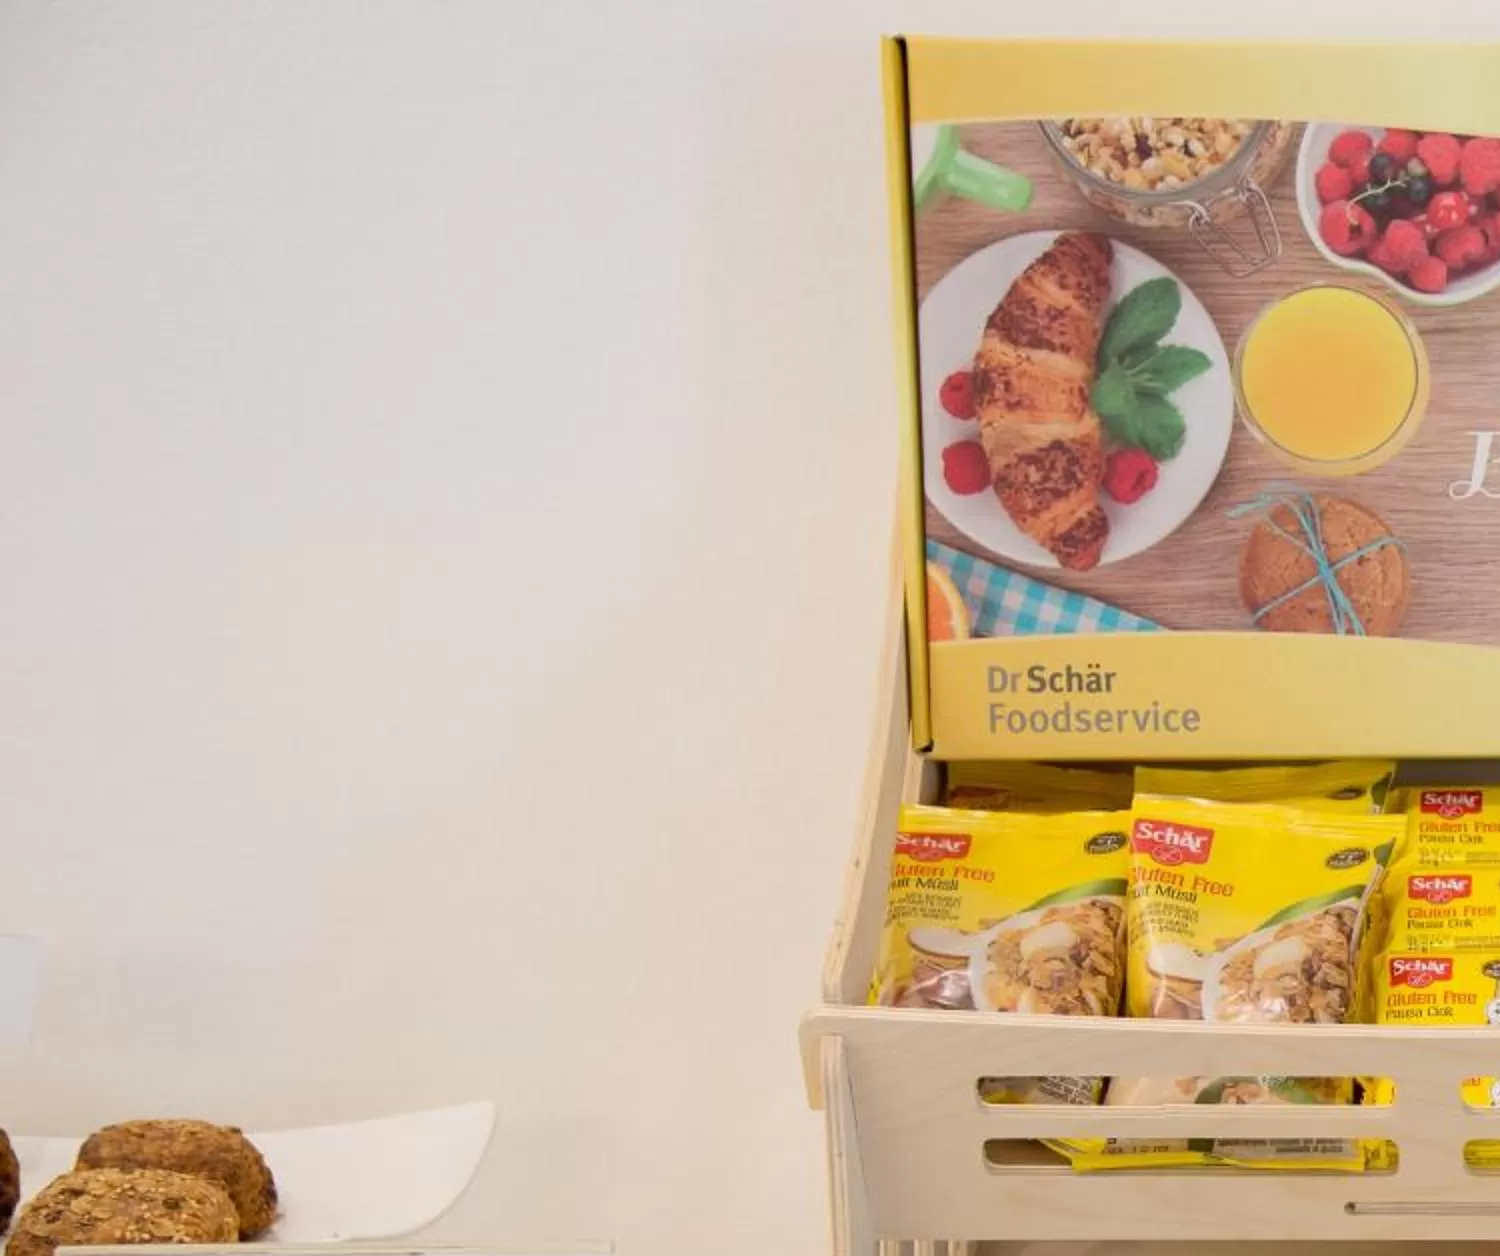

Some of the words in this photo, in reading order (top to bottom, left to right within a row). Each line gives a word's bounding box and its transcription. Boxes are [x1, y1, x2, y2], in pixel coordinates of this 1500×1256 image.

[986, 664, 1022, 693] Dr
[1026, 664, 1117, 693] Schär
[987, 701, 1202, 735] Foodservice
[1423, 791, 1479, 808] Schär
[1419, 821, 1468, 833] Gluten
[896, 832, 967, 852] Schär
[1134, 821, 1209, 853] Schär
[895, 863, 945, 878] luten
[953, 866, 995, 883] Free
[1192, 874, 1235, 897] Free
[1411, 875, 1469, 892] Schär
[1407, 907, 1458, 919] Gluten
[1463, 905, 1497, 918] Free
[1392, 958, 1450, 976] Schär
[1387, 991, 1437, 1007] Gluten
[1443, 991, 1478, 1006] Free
